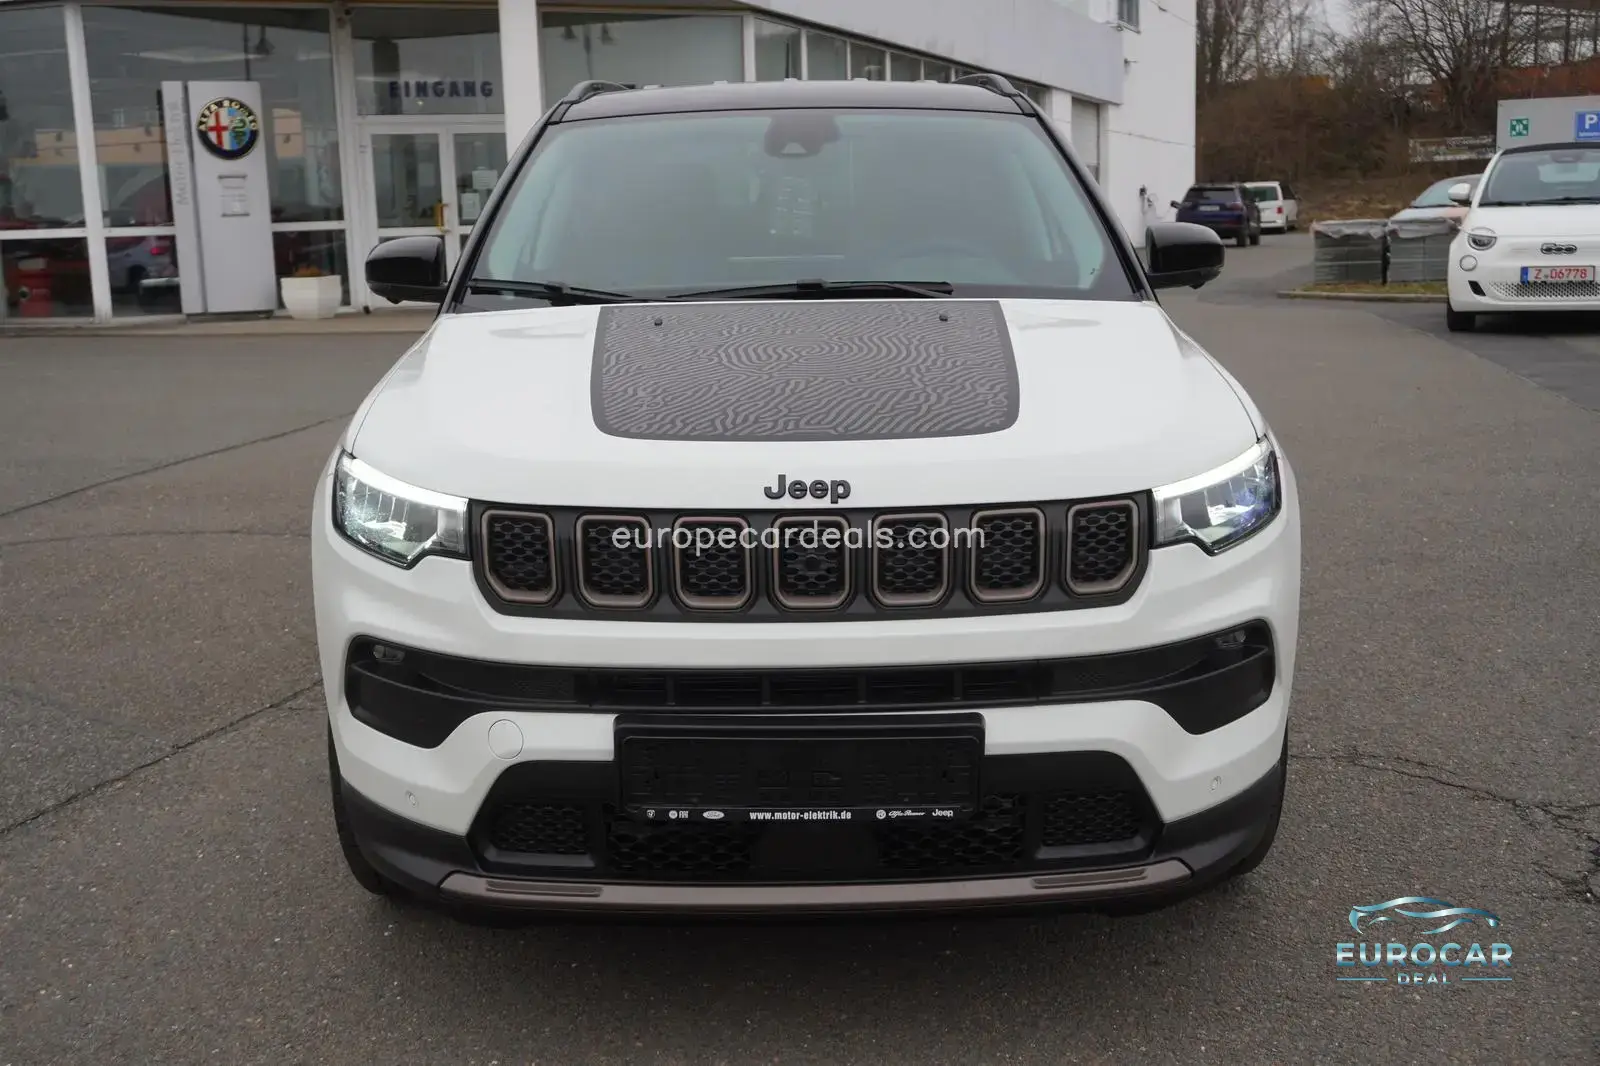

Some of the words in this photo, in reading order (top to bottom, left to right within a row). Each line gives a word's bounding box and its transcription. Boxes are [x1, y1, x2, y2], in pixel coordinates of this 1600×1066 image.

[388, 80, 494, 98] EINGANG
[1585, 114, 1598, 129] P
[764, 474, 851, 504] Jeep
[749, 810, 852, 821] www.motor-elektrik.de
[931, 808, 954, 818] Jeep
